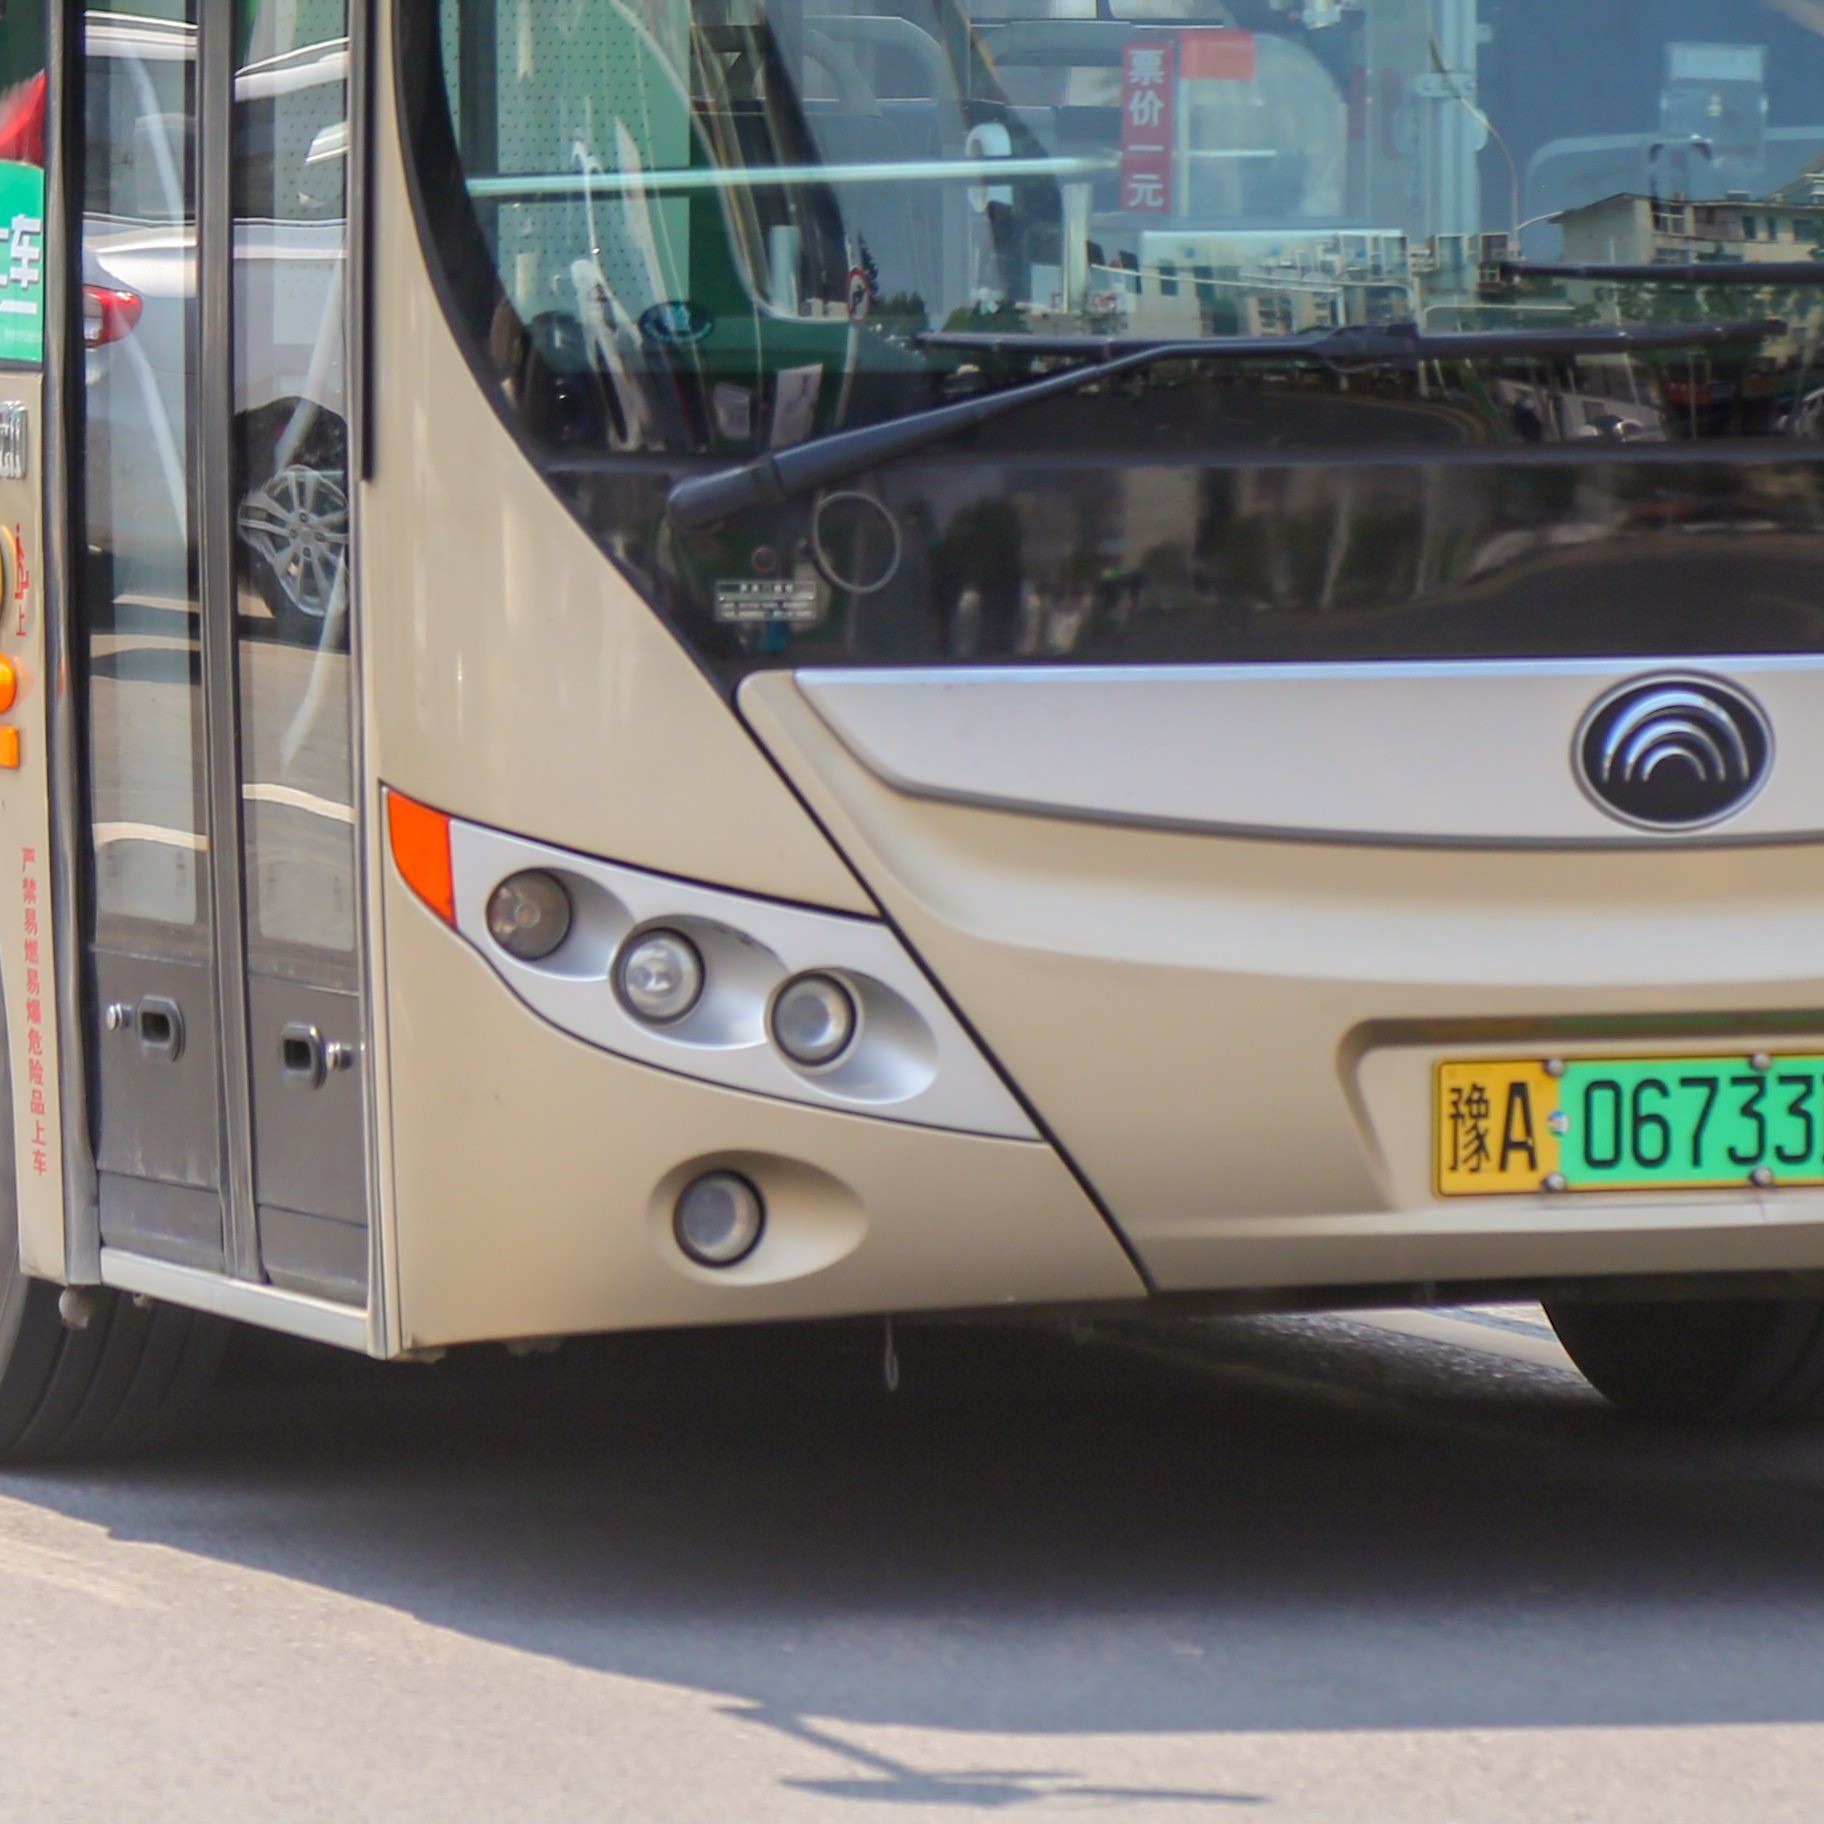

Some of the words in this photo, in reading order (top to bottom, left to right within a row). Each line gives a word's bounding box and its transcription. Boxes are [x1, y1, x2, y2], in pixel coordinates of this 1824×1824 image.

[1128, 49, 1165, 208] 票价一元
[21, 847, 48, 1176] 严禁易燃易爆危险品上车
[1447, 1080, 1539, 1174] 豫A
